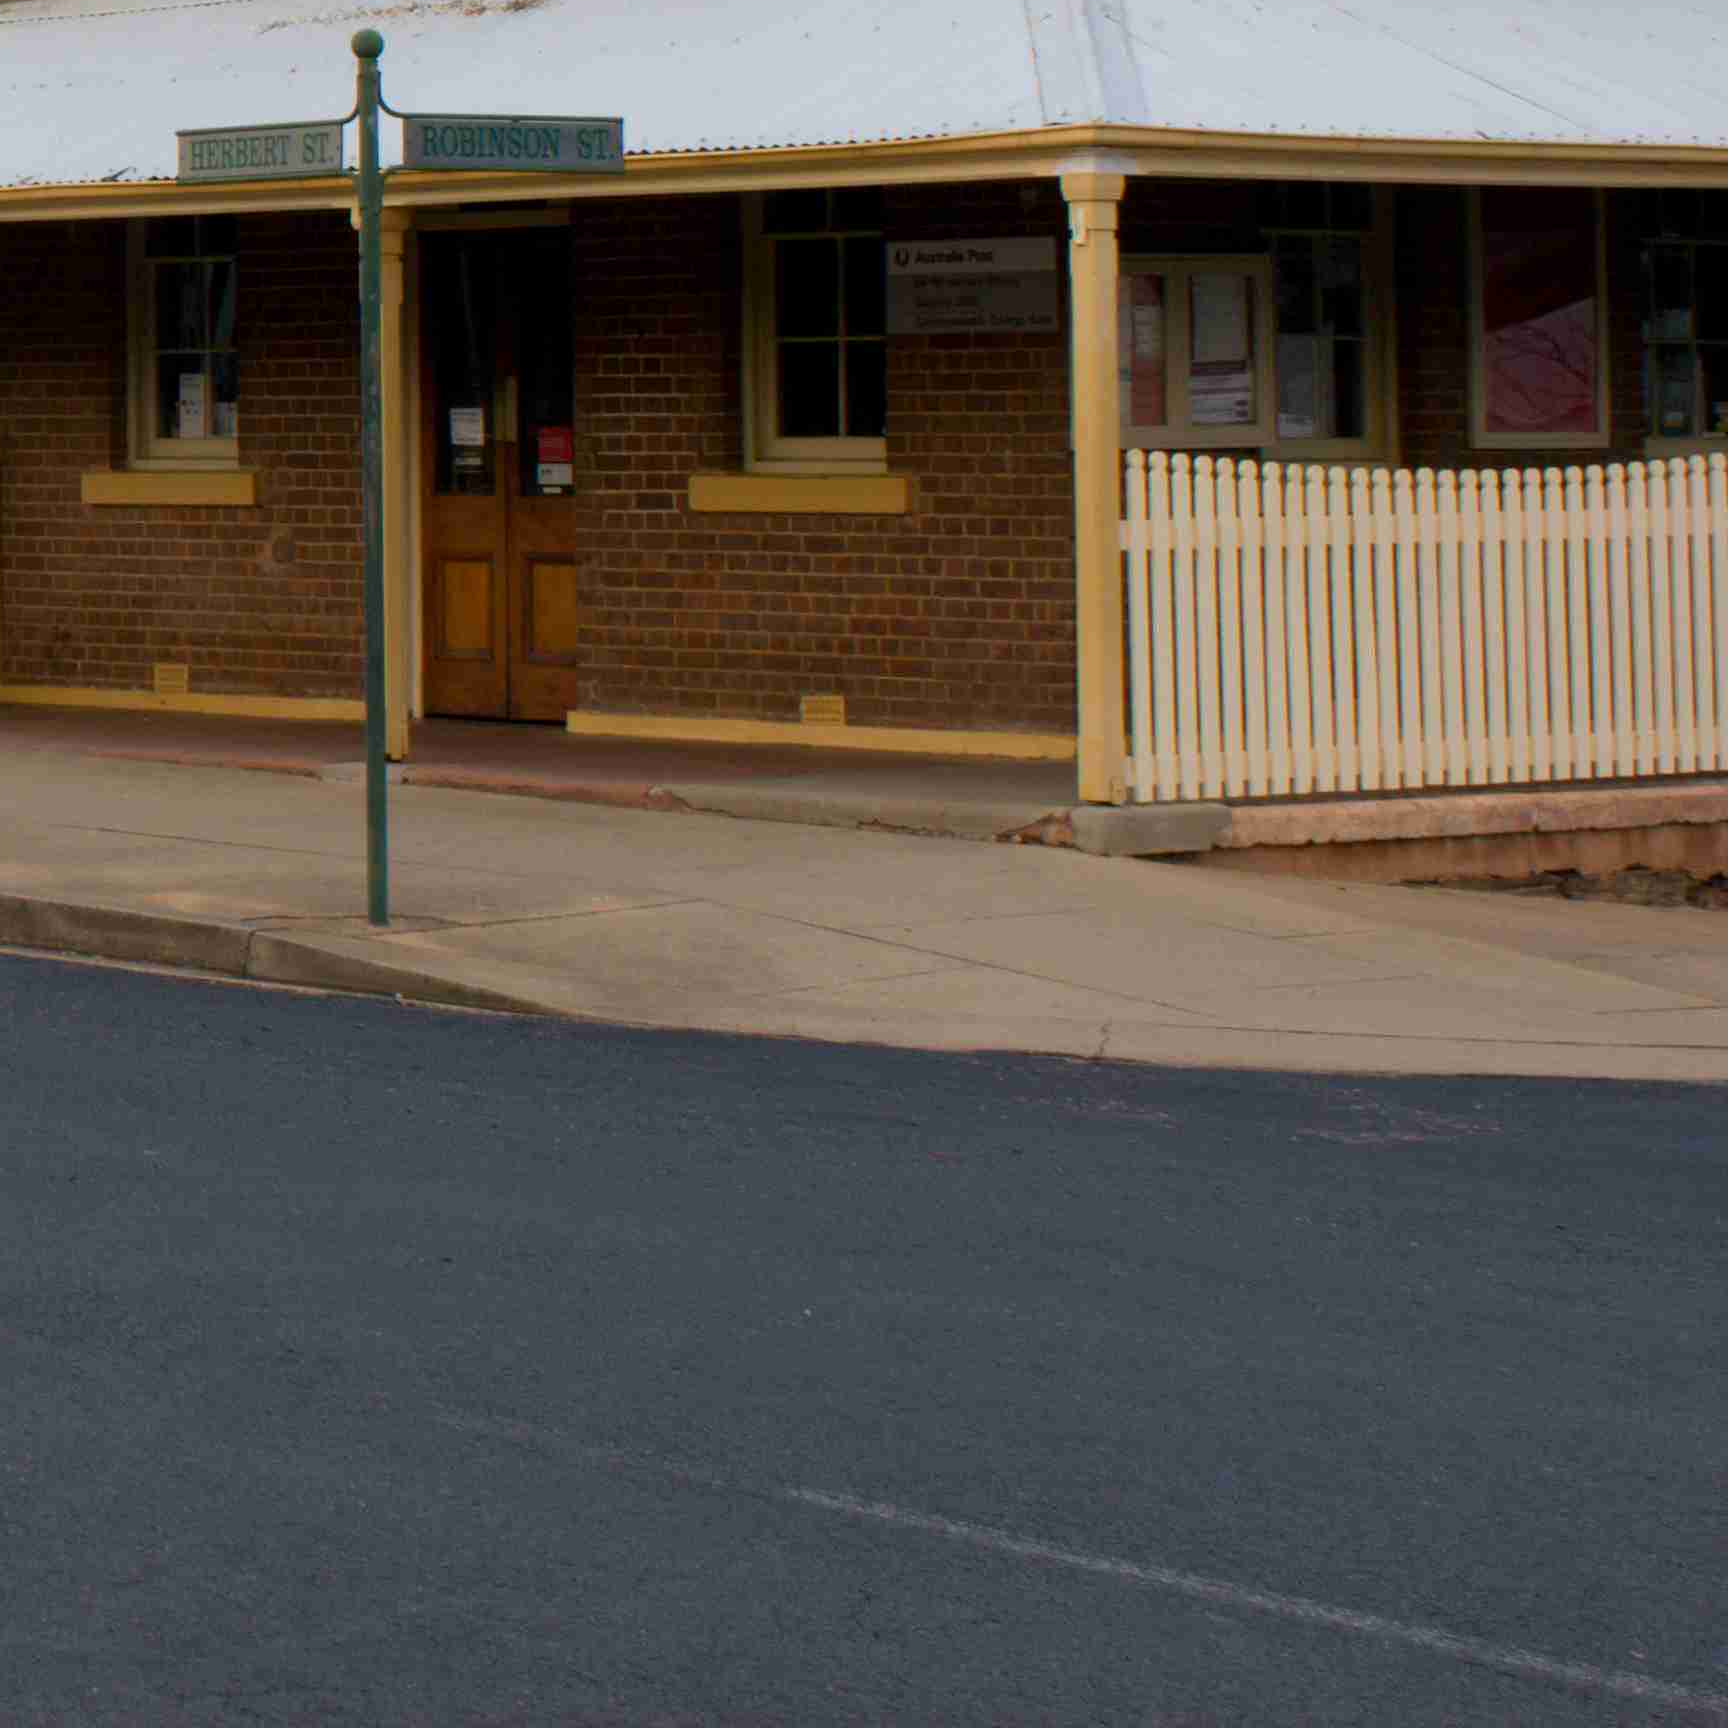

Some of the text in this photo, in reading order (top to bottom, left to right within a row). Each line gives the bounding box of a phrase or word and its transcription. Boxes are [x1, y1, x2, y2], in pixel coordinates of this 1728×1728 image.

[190, 133, 335, 171] HERBERT ST.
[422, 124, 616, 160] ROBINSON ST.
